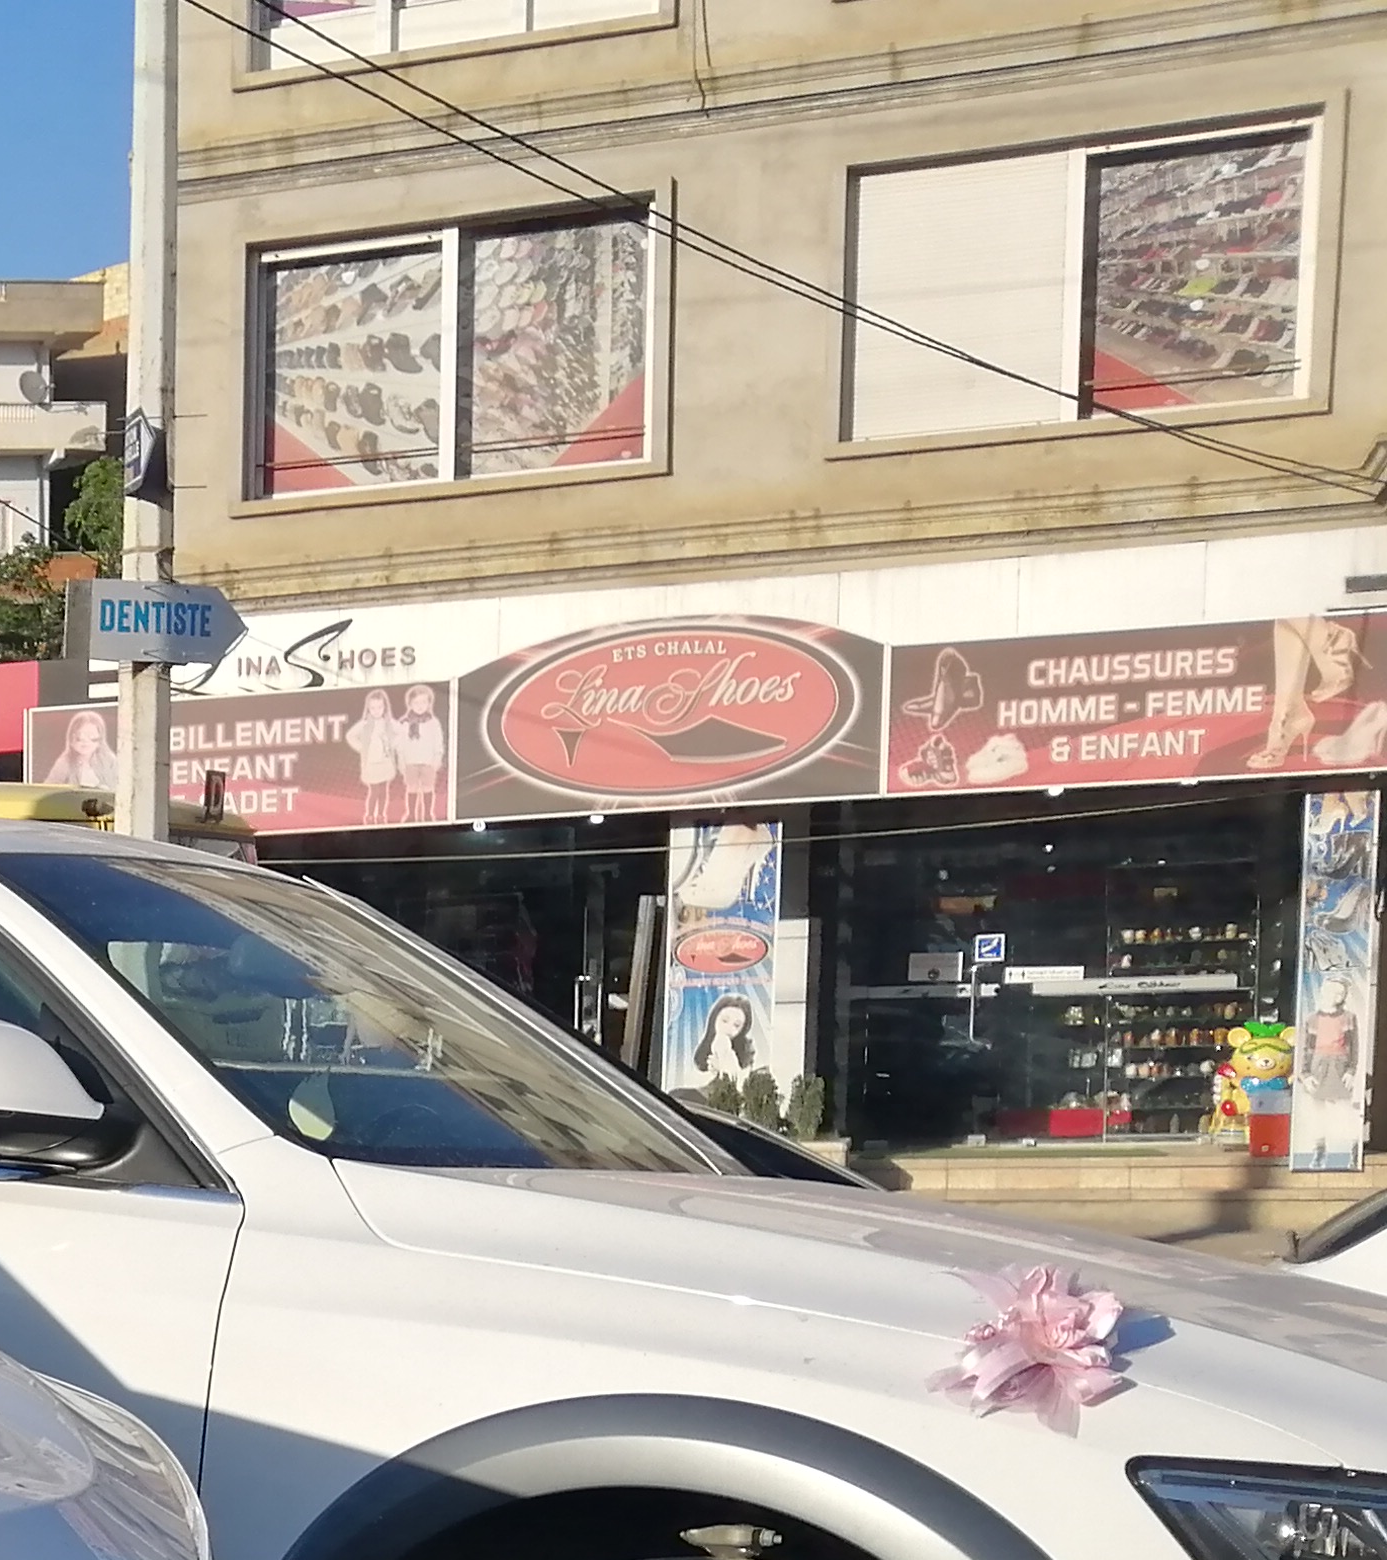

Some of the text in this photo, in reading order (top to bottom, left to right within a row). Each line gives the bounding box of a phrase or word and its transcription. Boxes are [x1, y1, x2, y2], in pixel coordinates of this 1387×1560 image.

[100, 599, 212, 637] DENTISTE
[612, 640, 727, 663] ETS CHALAL
[1029, 647, 1238, 688] CHAUSSURES
[541, 651, 802, 728] Lina Shoes
[998, 695, 1118, 728] HOMME
[1146, 686, 1264, 718] FEMME
[170, 714, 348, 751] BILLEMENT
[1051, 729, 1206, 763] & ENFANT
[200, 788, 299, 816] ADET
